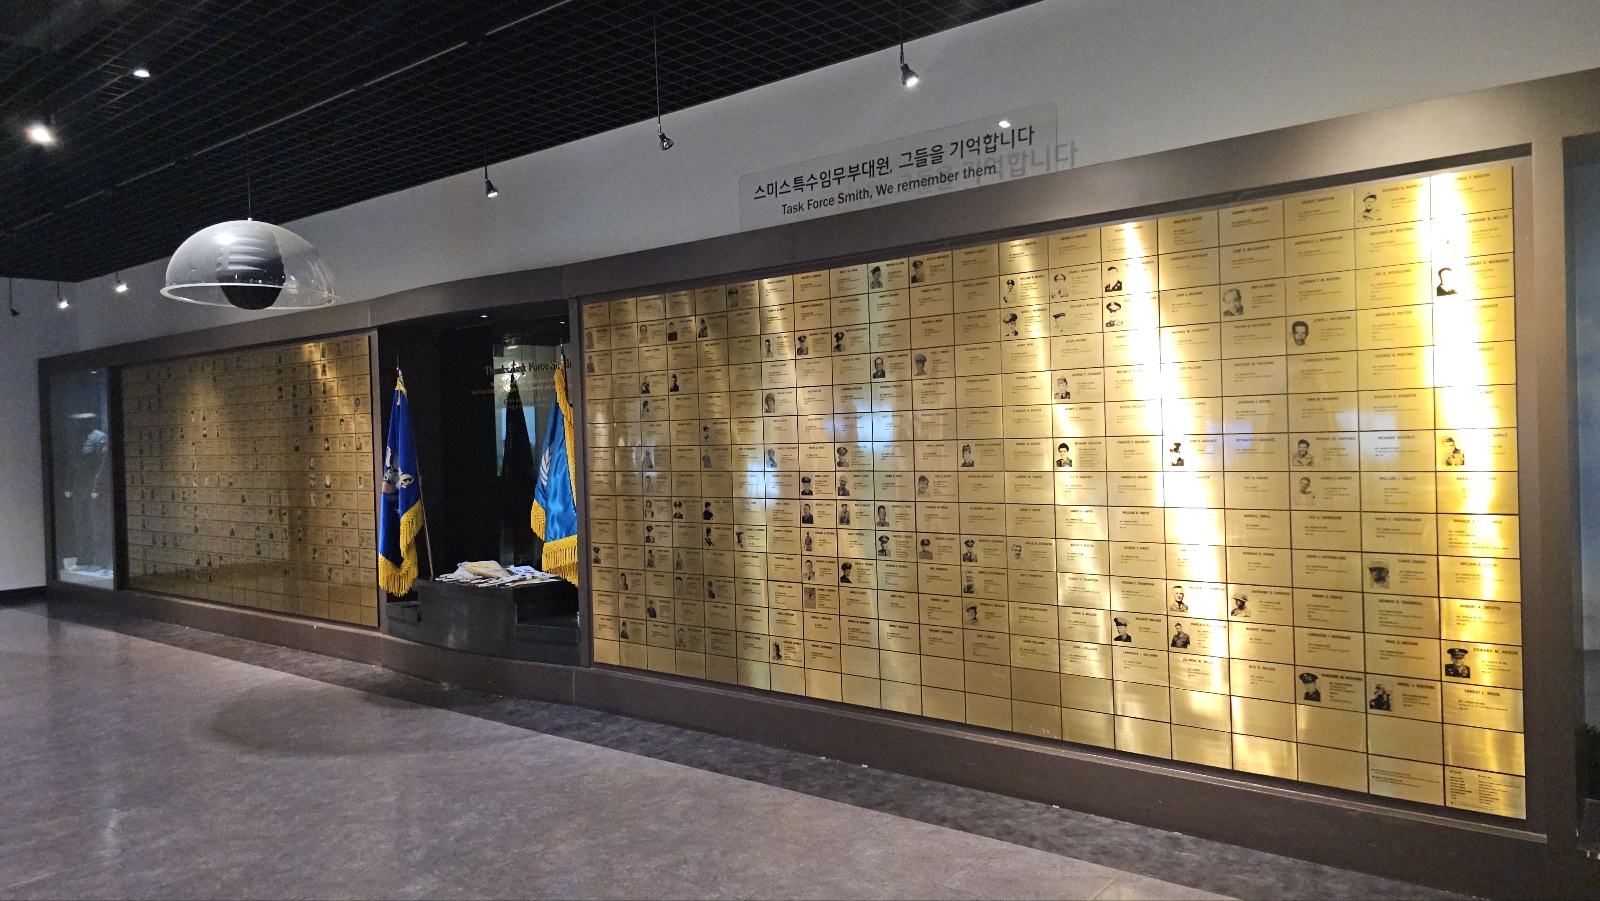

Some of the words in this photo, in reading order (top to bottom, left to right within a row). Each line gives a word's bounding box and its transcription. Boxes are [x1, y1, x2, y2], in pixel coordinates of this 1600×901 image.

[754, 156, 892, 200] 스미스특수임무부대원,
[898, 144, 945, 170] 그들을
[950, 125, 1035, 160] 기억합니다
[782, 201, 804, 216] Task
[807, 195, 834, 210] Force
[838, 187, 873, 204] Smith,
[876, 182, 894, 196] We
[897, 170, 960, 193] remember
[963, 163, 996, 181] them
[528, 361, 550, 372] Force
